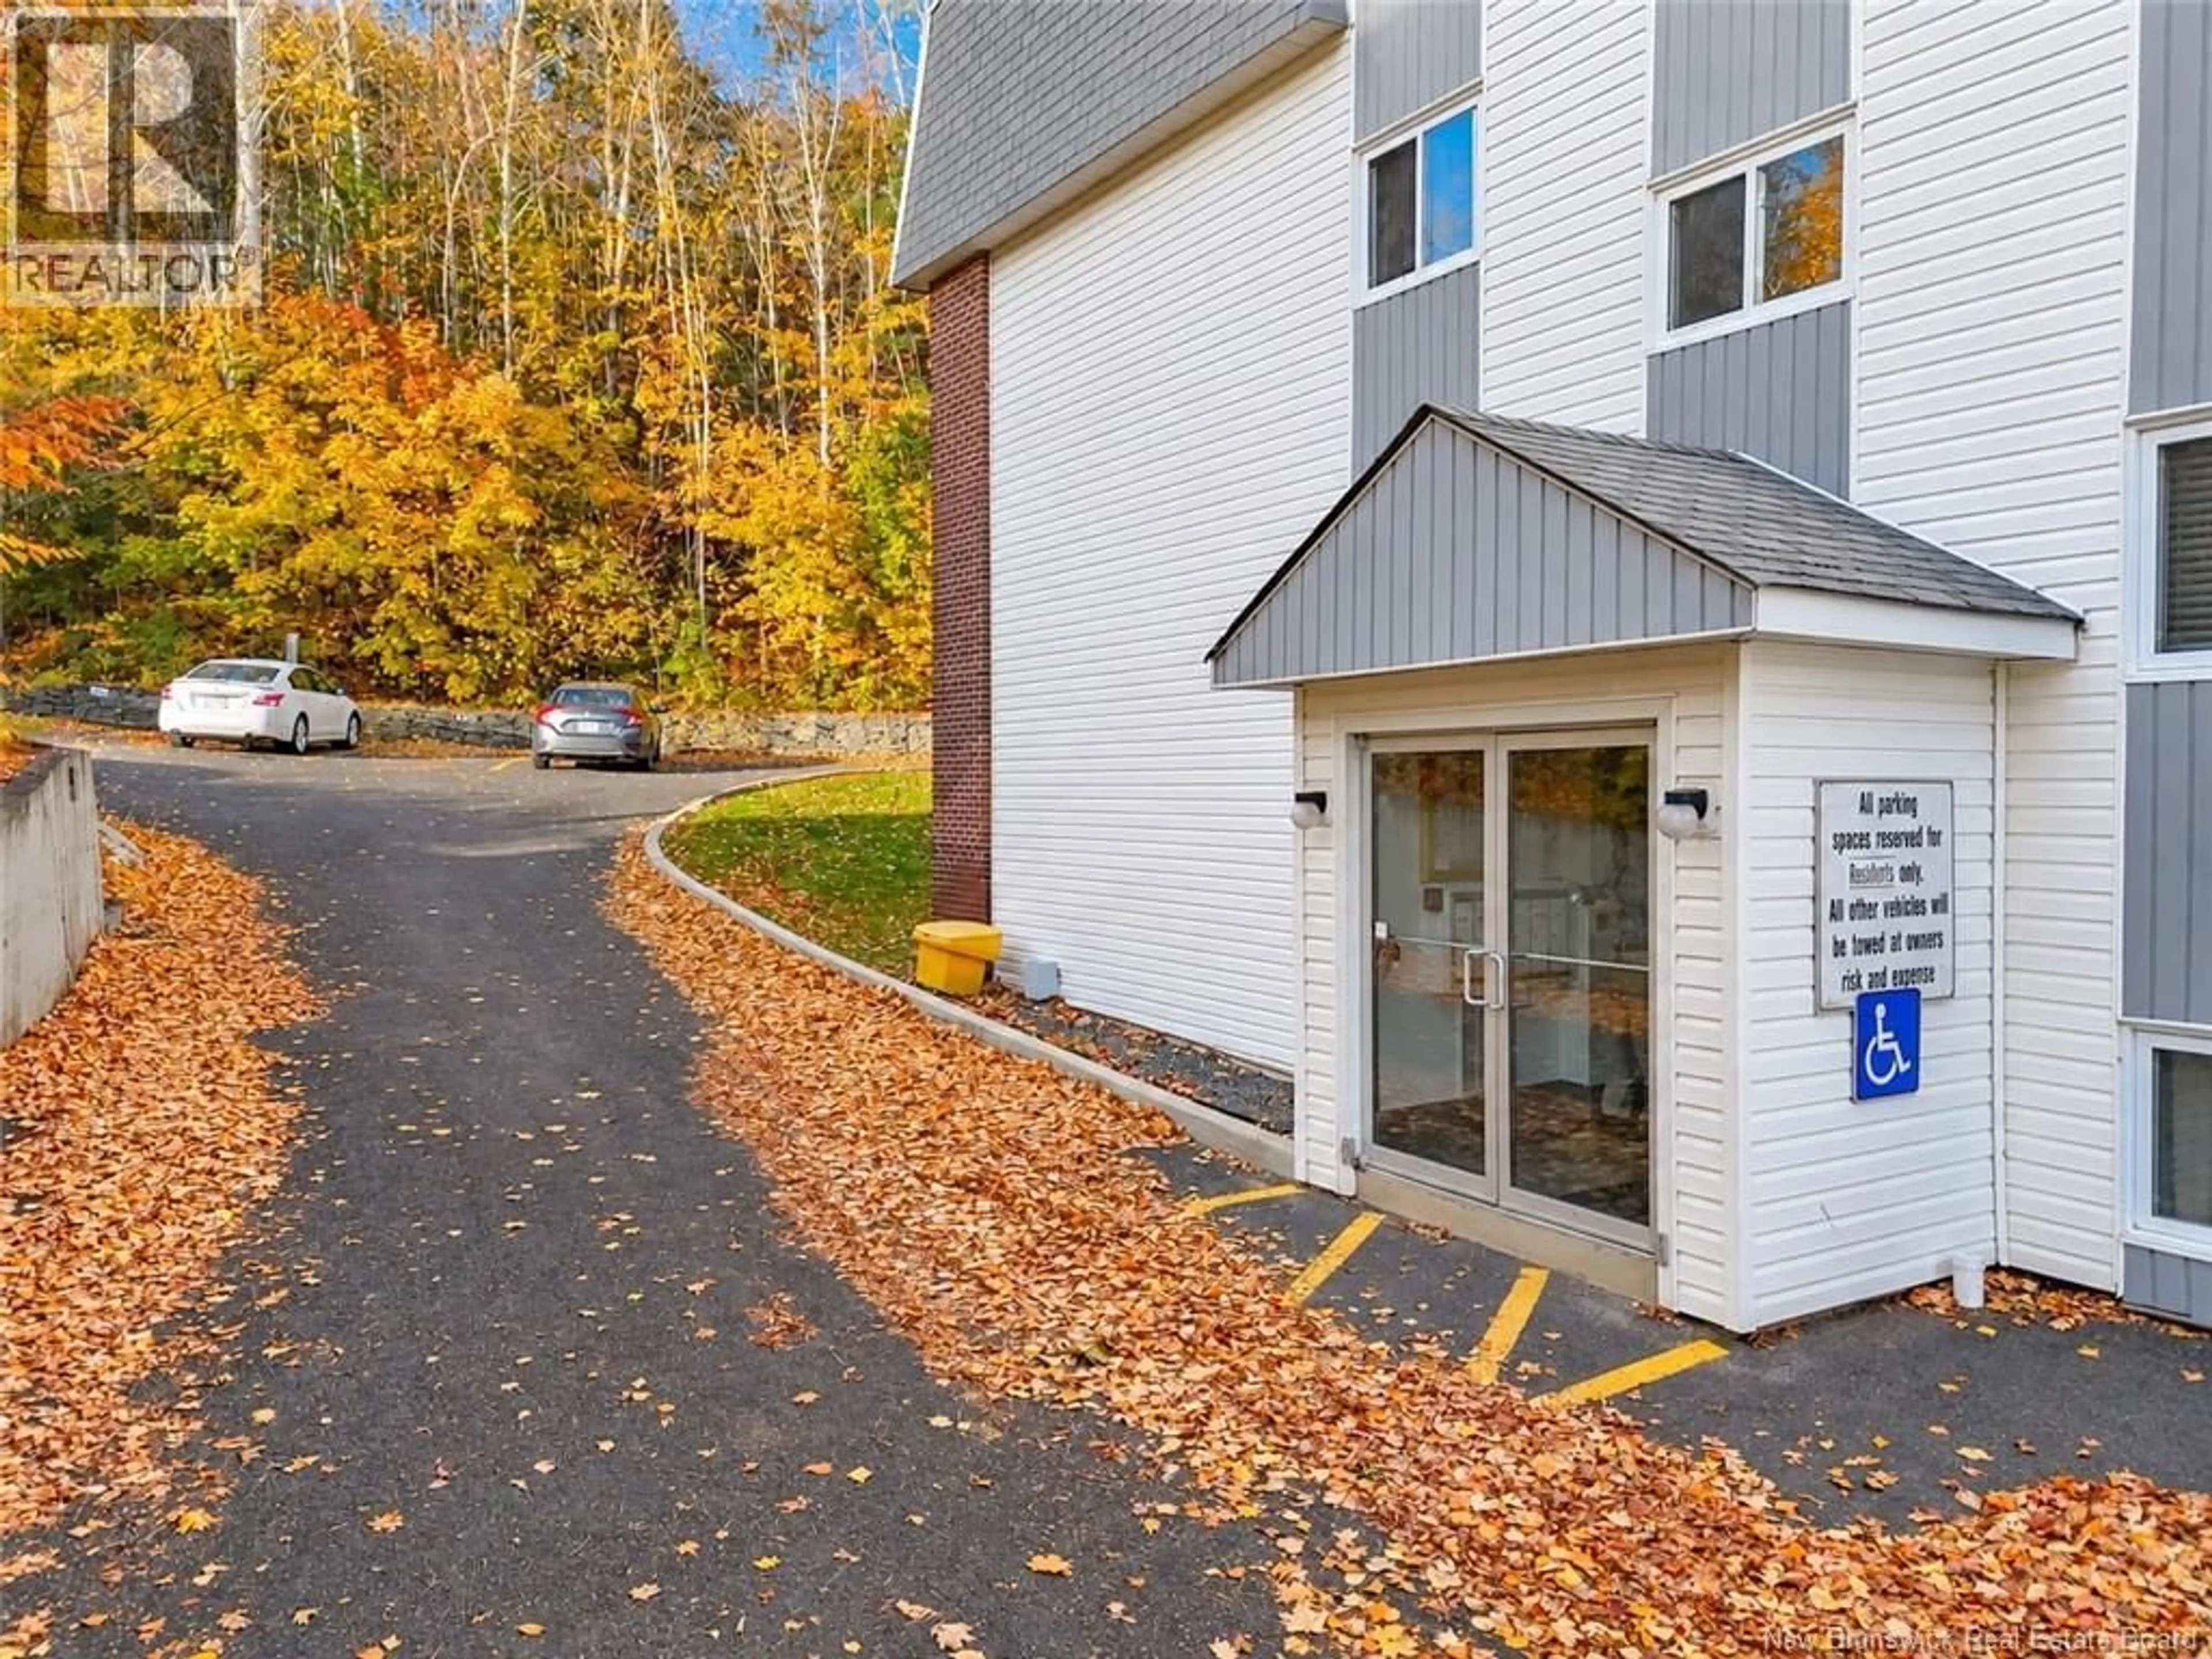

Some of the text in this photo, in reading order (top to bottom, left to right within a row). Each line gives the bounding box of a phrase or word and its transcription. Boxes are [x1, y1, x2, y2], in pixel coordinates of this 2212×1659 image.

[1859, 791, 1917, 819] All parking
[1832, 825, 1942, 855] spaces reserved for
[1899, 861, 1924, 887] only.
[1829, 893, 1949, 922] All other vehicles will
[1832, 930, 1943, 958] be towed at owners
[1842, 966, 1934, 993] risk and expense
